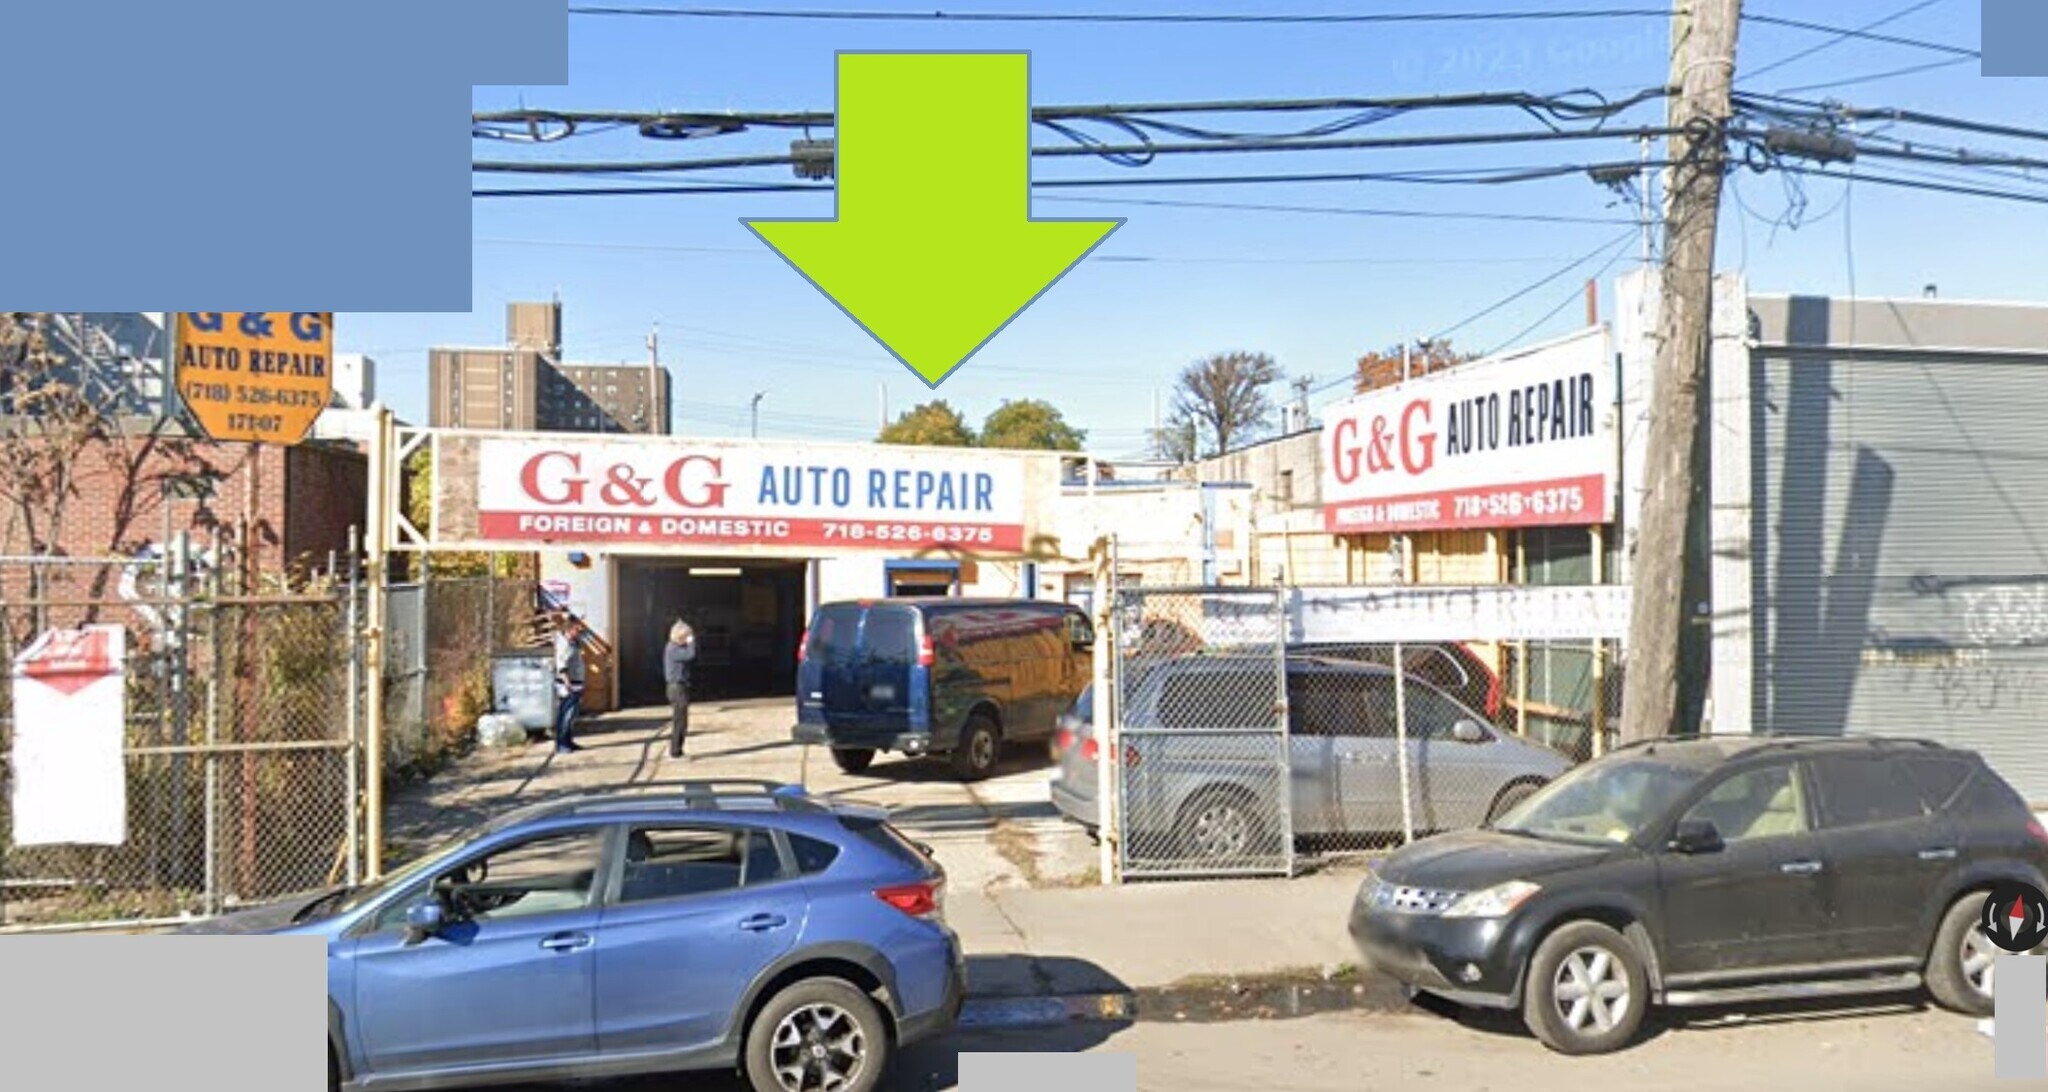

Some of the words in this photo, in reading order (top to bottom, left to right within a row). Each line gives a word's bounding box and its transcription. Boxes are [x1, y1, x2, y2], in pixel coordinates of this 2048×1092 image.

[182, 343, 240, 371] AUTO
[249, 349, 325, 378] REPAIR
[1446, 392, 1499, 456] AUTO
[1508, 372, 1594, 448] REPAIR
[757, 465, 851, 508] AUTO
[867, 468, 994, 512] REPAIR
[518, 515, 632, 534] FOREIGN
[637, 519, 653, 534] &
[660, 517, 790, 538] DOMESTIC
[822, 522, 993, 542] 718-526-6375
